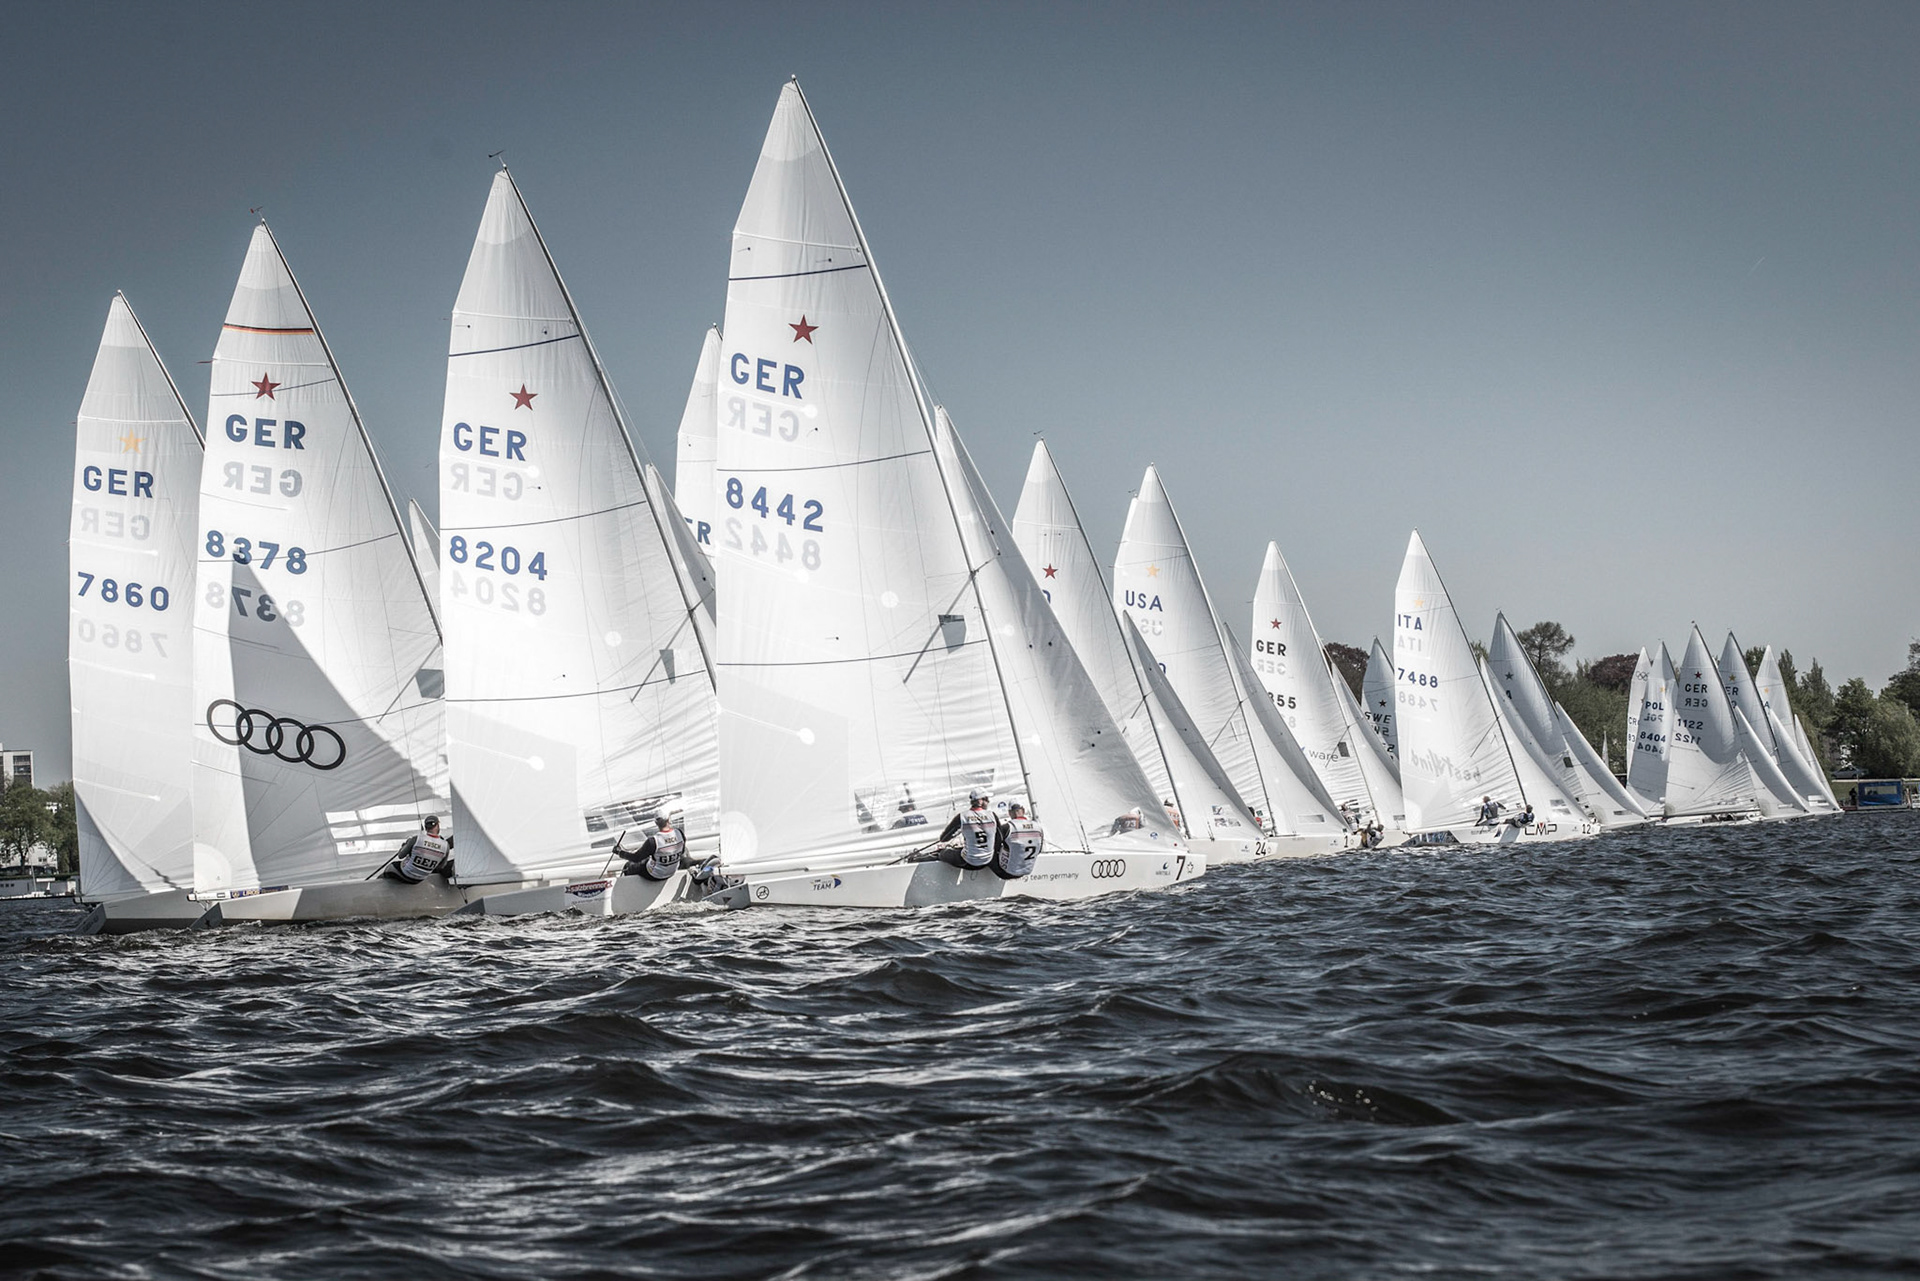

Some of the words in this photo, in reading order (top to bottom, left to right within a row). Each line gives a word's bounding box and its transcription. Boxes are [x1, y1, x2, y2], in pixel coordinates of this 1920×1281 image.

[731, 352, 805, 400] GER
[225, 414, 307, 450] GER
[453, 422, 527, 461] GER
[83, 465, 154, 498] GER
[726, 477, 824, 532] 8442
[205, 530, 308, 575] 8378
[449, 535, 548, 581] 8204
[76, 571, 170, 611] 7860
[1125, 590, 1163, 612] USA
[1397, 613, 1423, 631] ITA
[1256, 639, 1287, 657] GER
[1397, 668, 1439, 689] 7488
[1685, 684, 1708, 693] GER
[1645, 701, 1664, 711] POL
[1364, 711, 1392, 724] SWE
[1677, 719, 1704, 730] 1122
[1640, 731, 1666, 742] 8404
[1524, 822, 1558, 836] CMP
[1581, 823, 1591, 834] 12
[1024, 846, 1036, 860] 2
[1255, 841, 1267, 856] 24
[413, 856, 438, 868] GER
[1176, 855, 1186, 881] 7
[813, 882, 832, 891] TEAM
